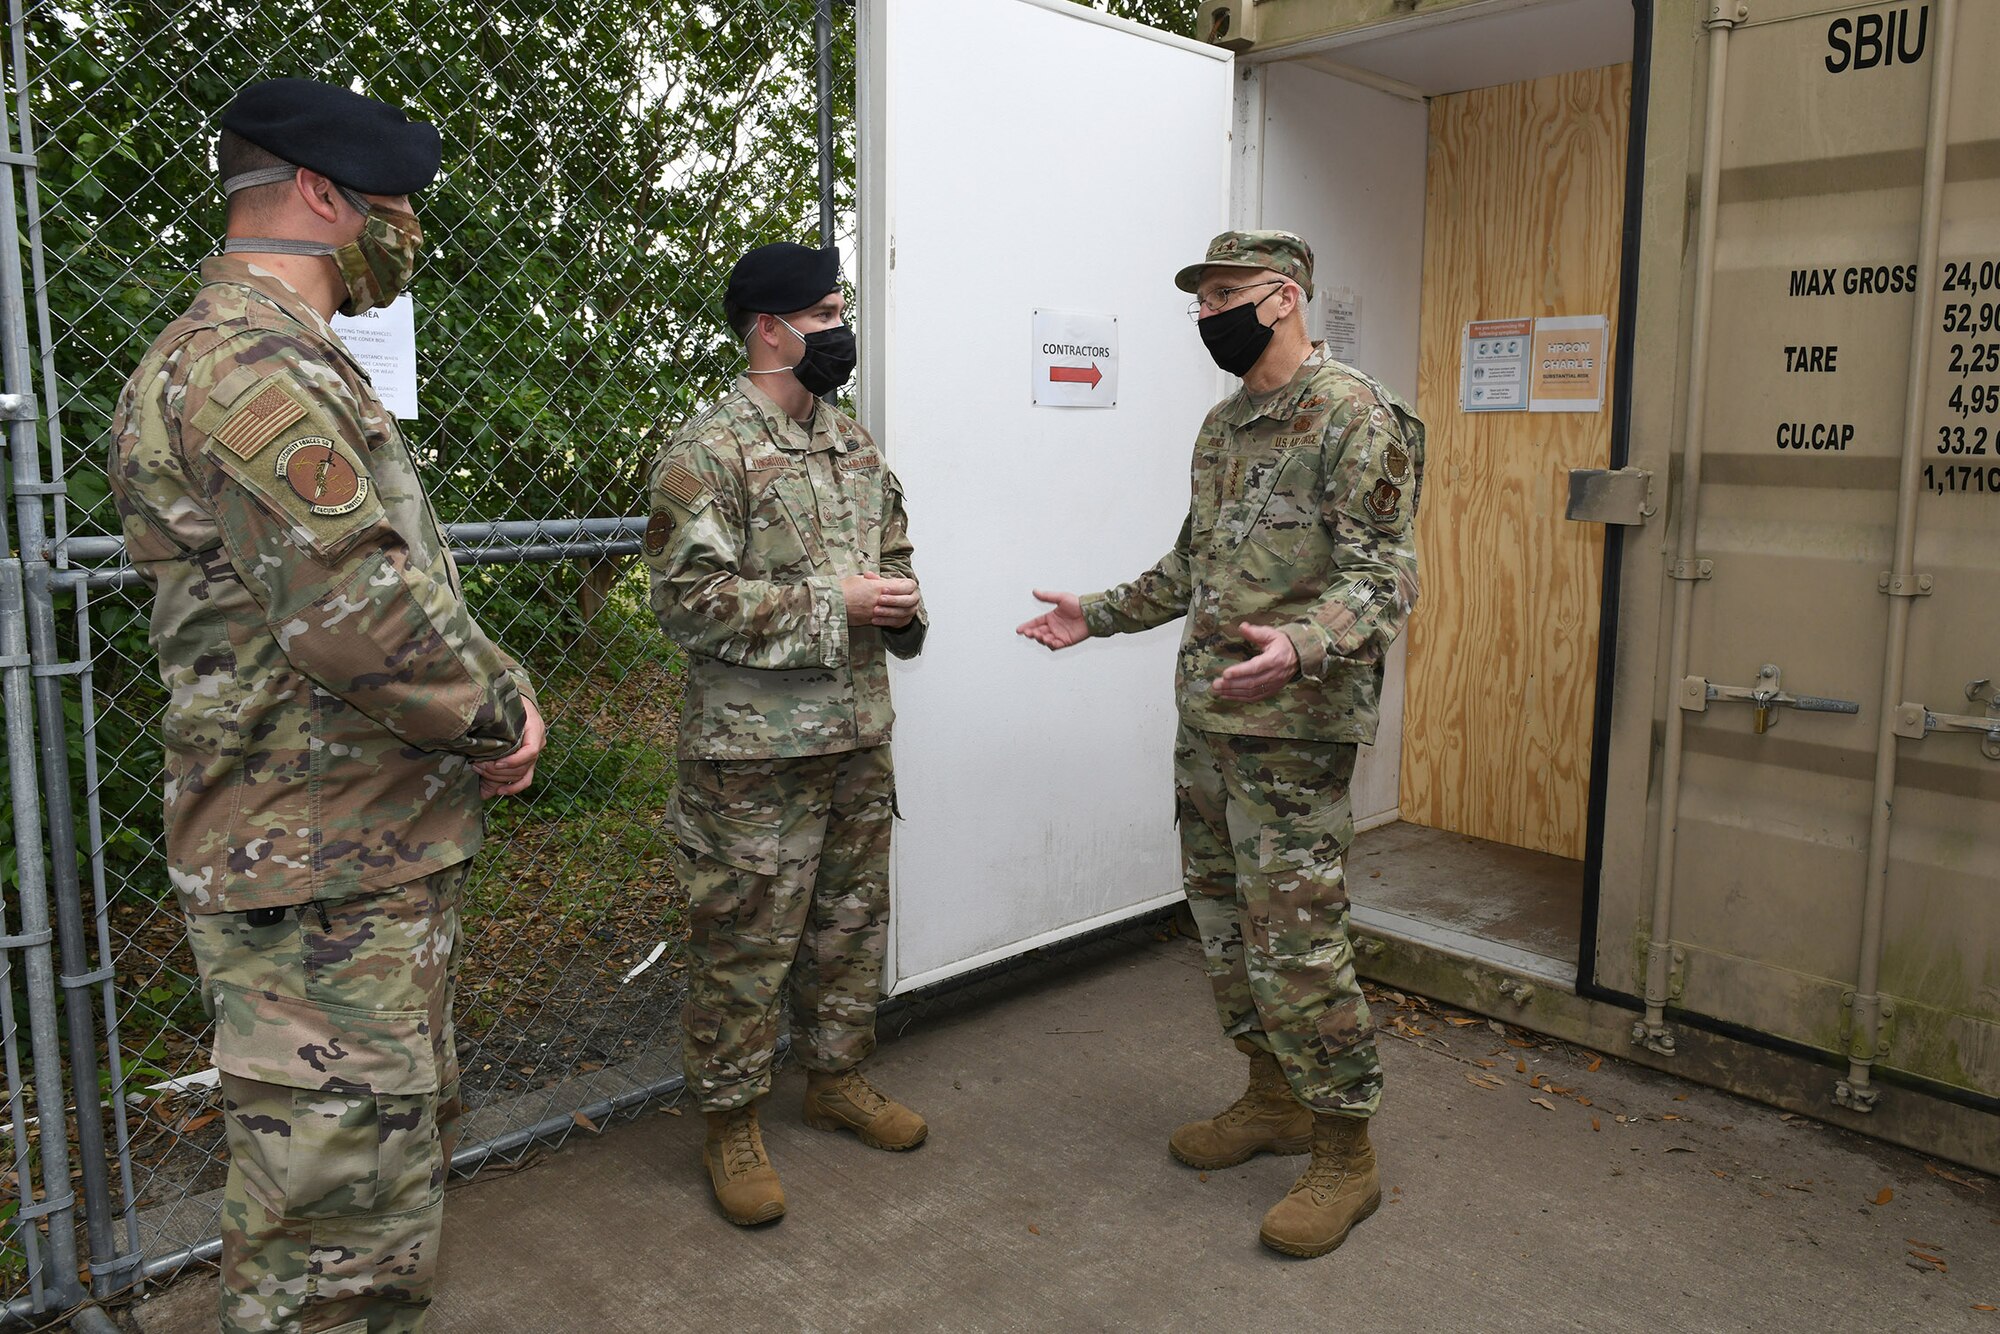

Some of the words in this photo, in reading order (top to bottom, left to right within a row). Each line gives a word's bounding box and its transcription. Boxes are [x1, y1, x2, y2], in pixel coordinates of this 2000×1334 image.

[1825, 6, 1929, 74] SBIU
[1789, 268, 1837, 297] MAX
[1843, 265, 1918, 295] GROSS
[1042, 343, 1110, 358] CONTRACTORS
[1547, 341, 1591, 353] HPCON
[1784, 345, 1838, 373] TARE
[1542, 358, 1594, 370] CHARLIE
[1776, 423, 1855, 451] CU.CAP
[1937, 425, 1988, 455] 33.2
